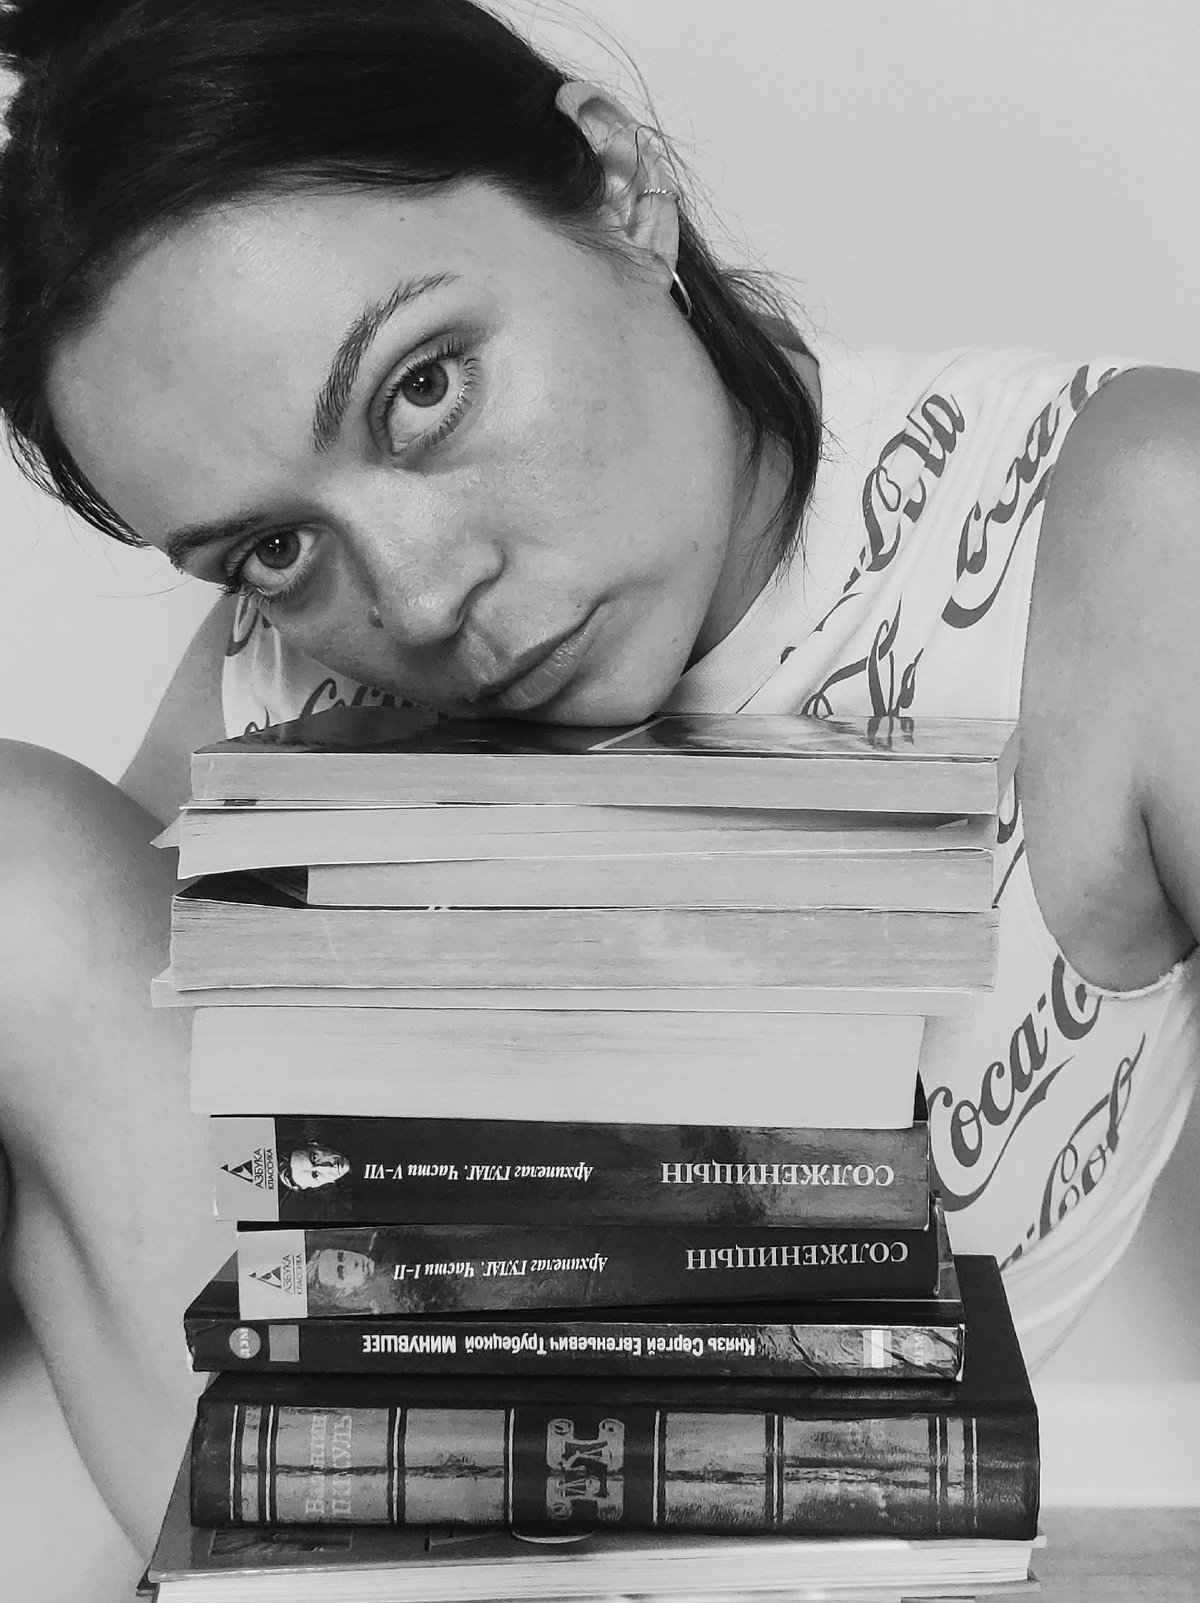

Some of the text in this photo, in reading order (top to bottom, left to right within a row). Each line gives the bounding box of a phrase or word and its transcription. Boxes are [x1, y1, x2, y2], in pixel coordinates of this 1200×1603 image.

[253, 1148, 264, 1189] АЗБУКА
[407, 1164, 459, 1181] Части
[464, 1164, 512, 1181] ГУЛАГ.
[514, 1161, 594, 1182] Архипелаг
[660, 1158, 895, 1186] СОЛЖЕНИЦЫН
[530, 1252, 609, 1273] Архипелаг
[685, 1241, 909, 1270] СОЛЖЕНИЦЫН
[424, 1262, 475, 1278] Части
[481, 1259, 527, 1278] ГУЛАГ.
[362, 1333, 756, 1357] Князь Сергей Евгеньевич Трубецкой МИНУВШЕЕ
